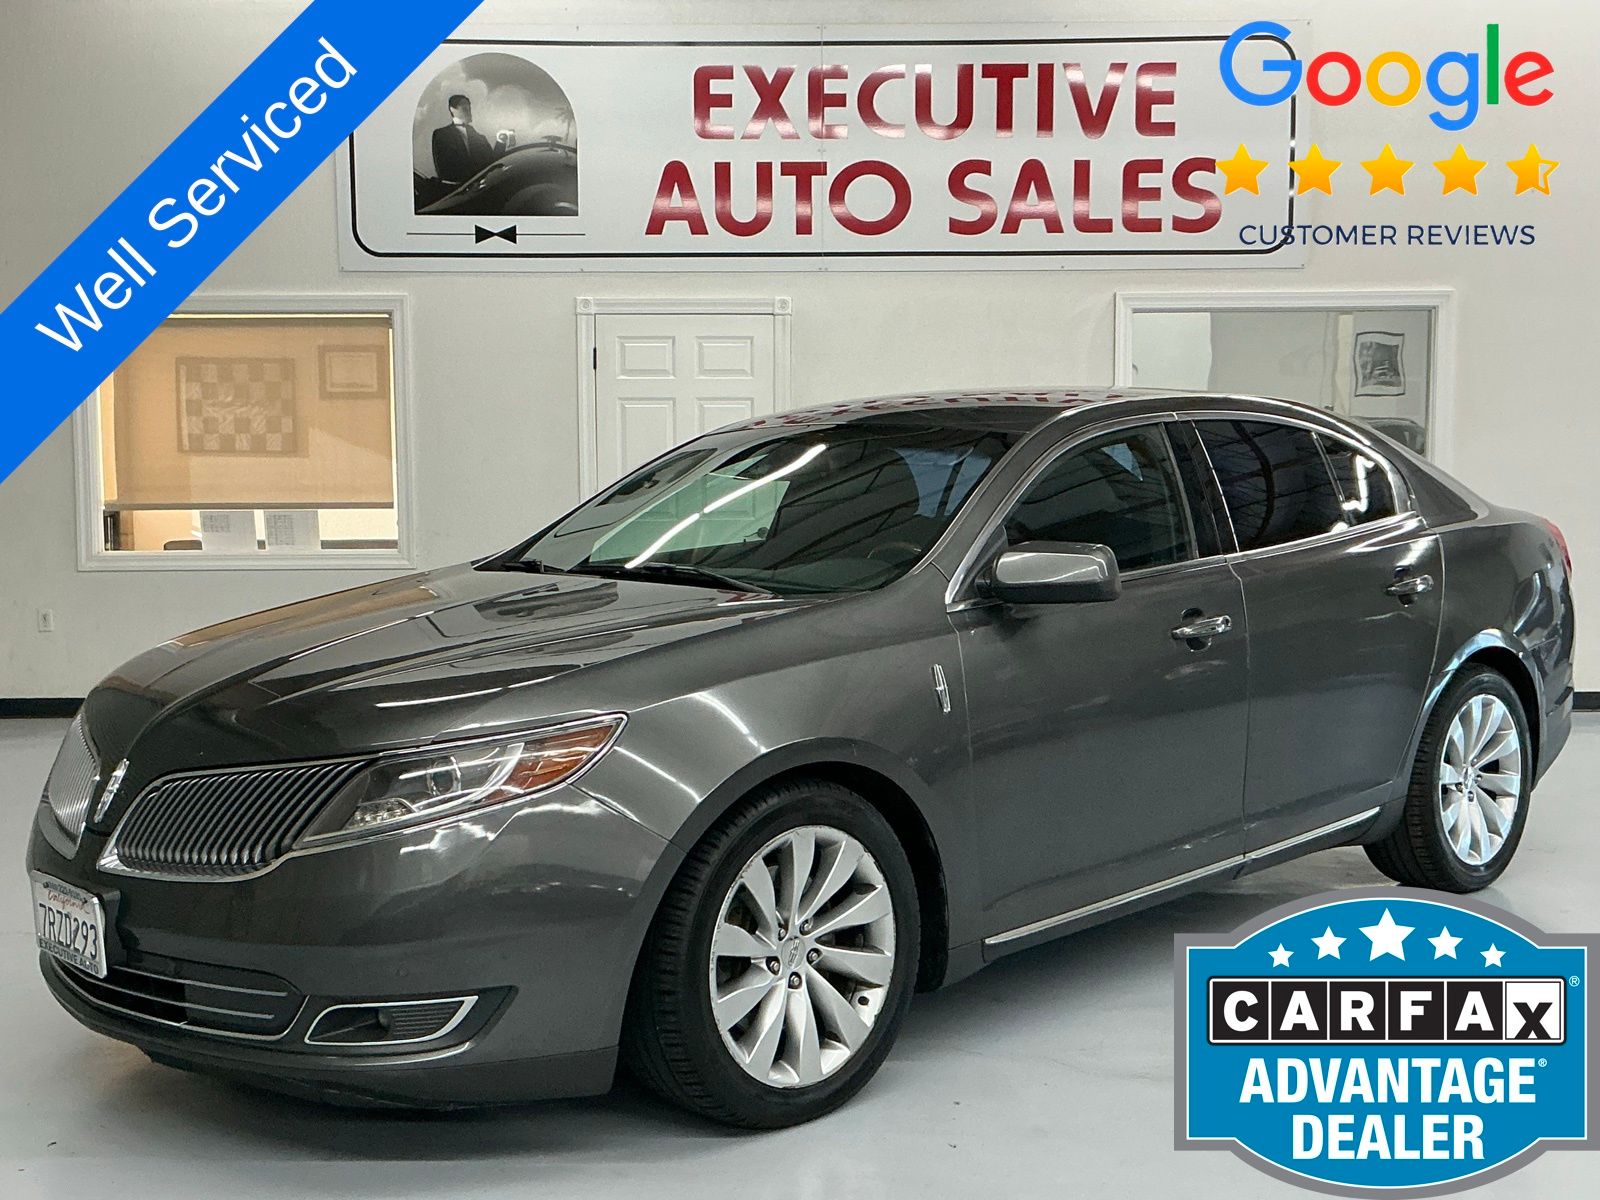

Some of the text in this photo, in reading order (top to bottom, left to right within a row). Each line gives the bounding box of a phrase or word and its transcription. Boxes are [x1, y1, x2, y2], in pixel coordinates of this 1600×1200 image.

[692, 62, 1178, 140] EXECUTIVE
[645, 157, 1223, 237] AUTO SALES
[38, 902, 98, 961] 7RZD293
[40, 939, 79, 964] EXECUTIVE
